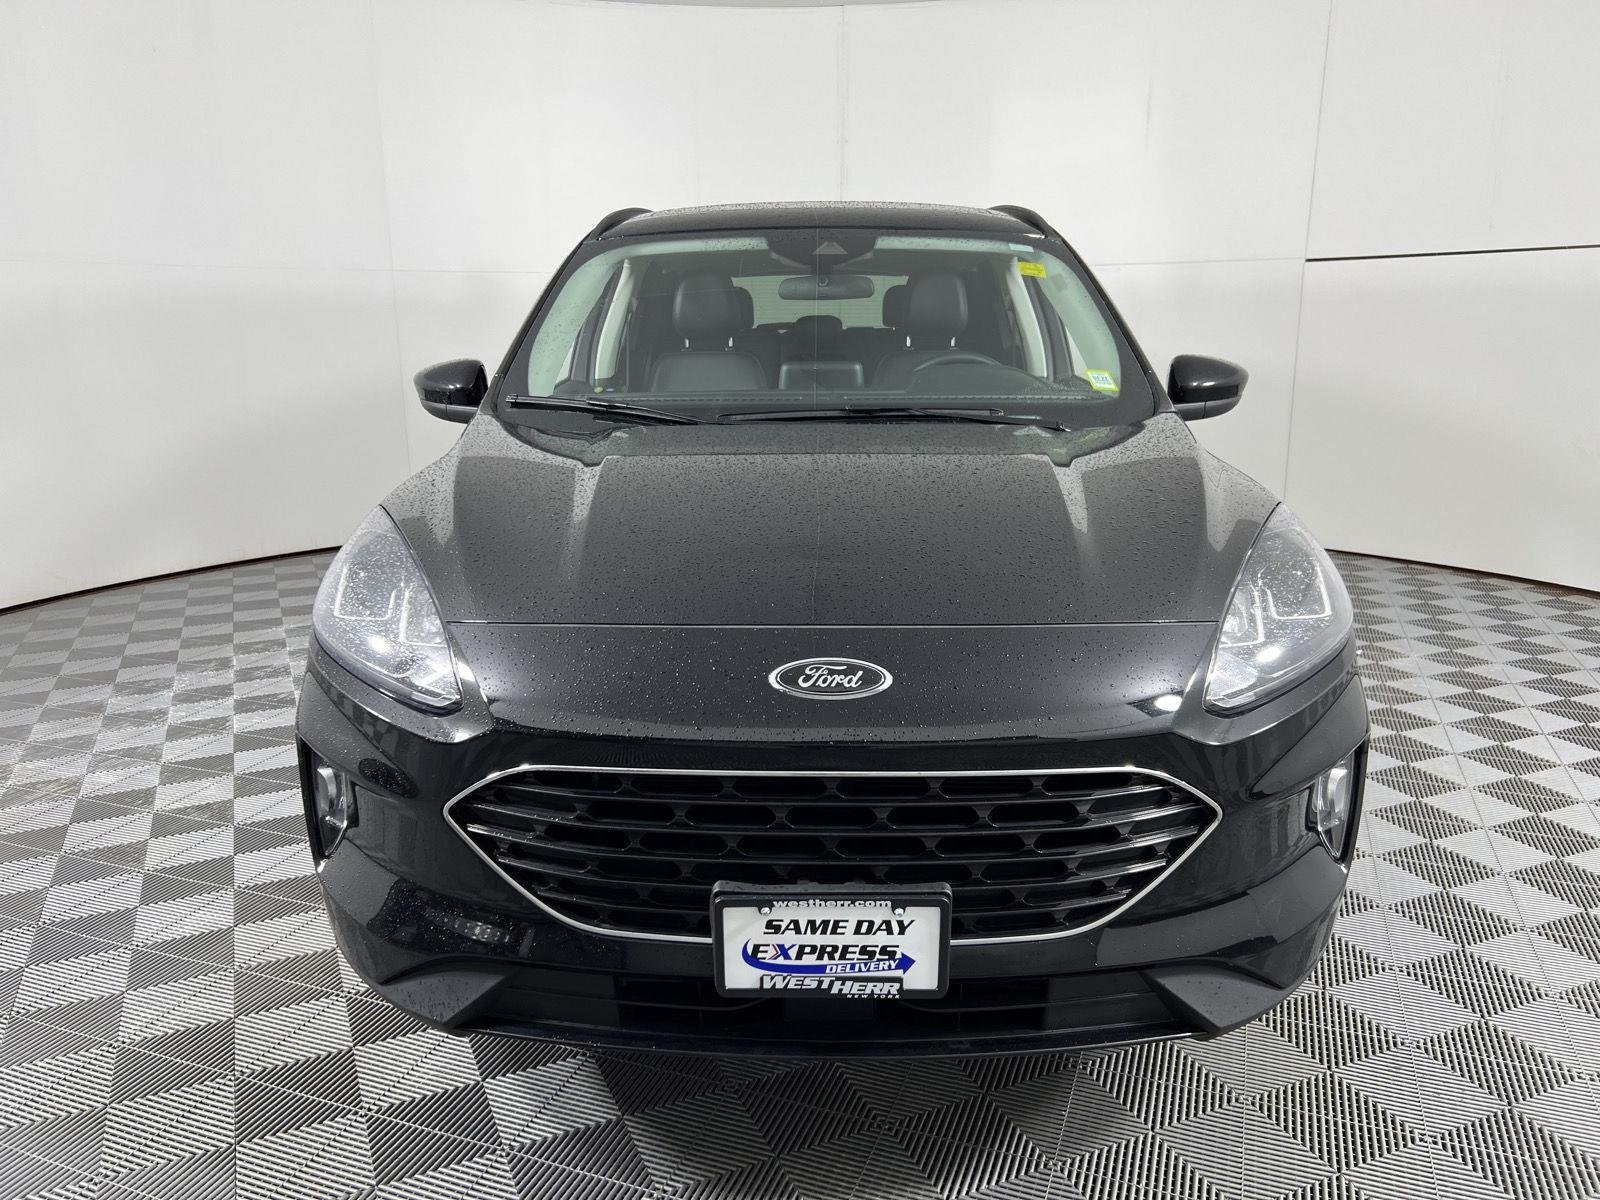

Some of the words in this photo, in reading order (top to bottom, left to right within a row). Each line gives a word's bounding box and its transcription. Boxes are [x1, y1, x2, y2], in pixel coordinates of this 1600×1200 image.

[798, 664, 864, 688] Ford
[772, 899, 892, 908] westherr.com
[763, 919, 849, 936] SAME
[853, 919, 915, 936] DAY
[750, 943, 900, 961] EXPRESS
[825, 959, 901, 975] DELIVERY
